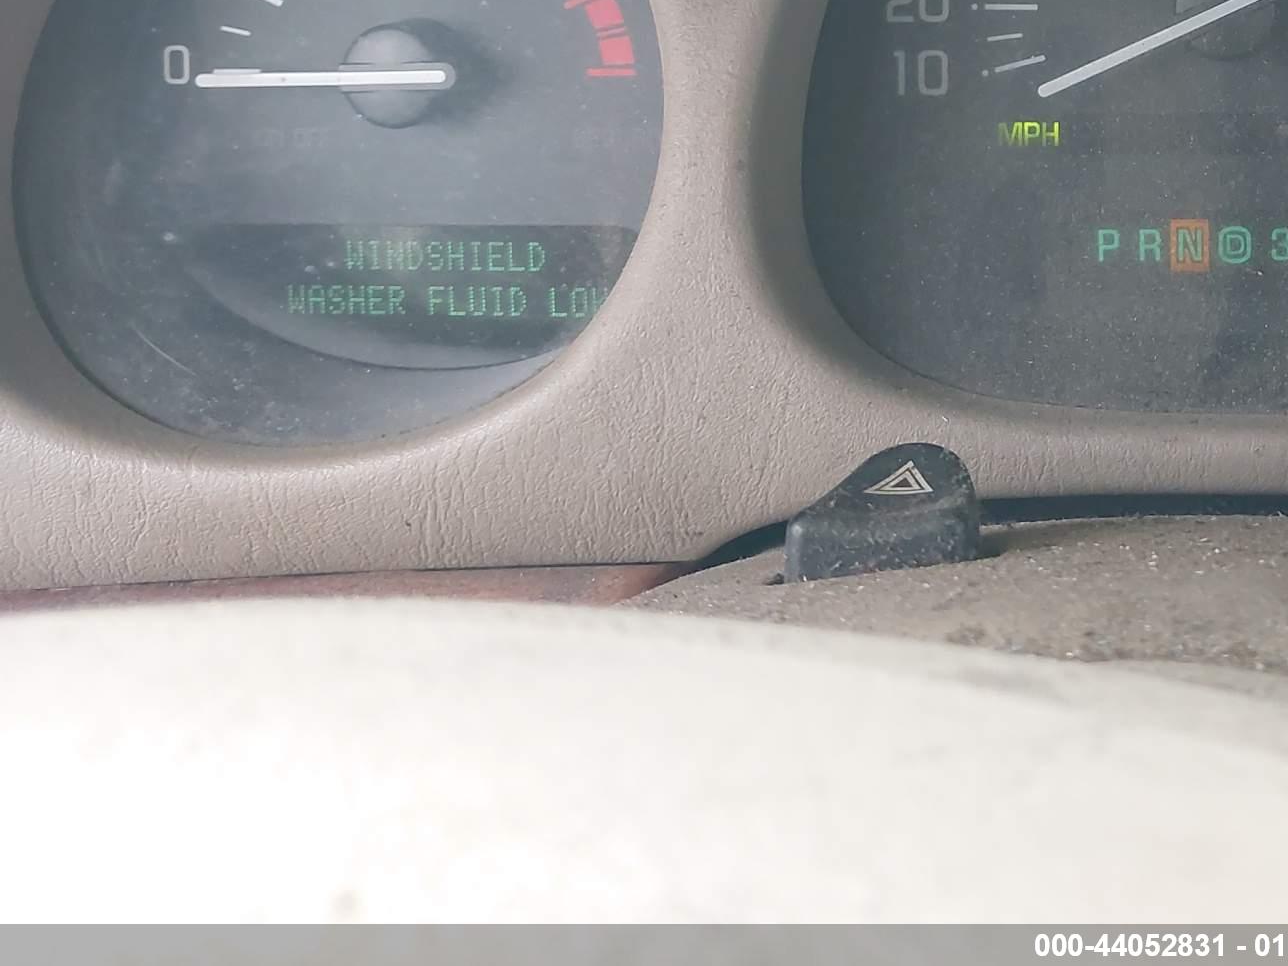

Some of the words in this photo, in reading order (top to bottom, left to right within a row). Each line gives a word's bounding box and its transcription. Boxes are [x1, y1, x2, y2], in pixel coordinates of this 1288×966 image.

[163, 45, 190, 84] 0
[893, 49, 949, 96] 10
[998, 121, 1060, 147] MPH
[345, 240, 547, 272] WINDSHIELD
[1097, 229, 1120, 262] P
[1139, 229, 1162, 262] R
[288, 285, 407, 316] WASHER
[429, 286, 528, 317] FLUID
